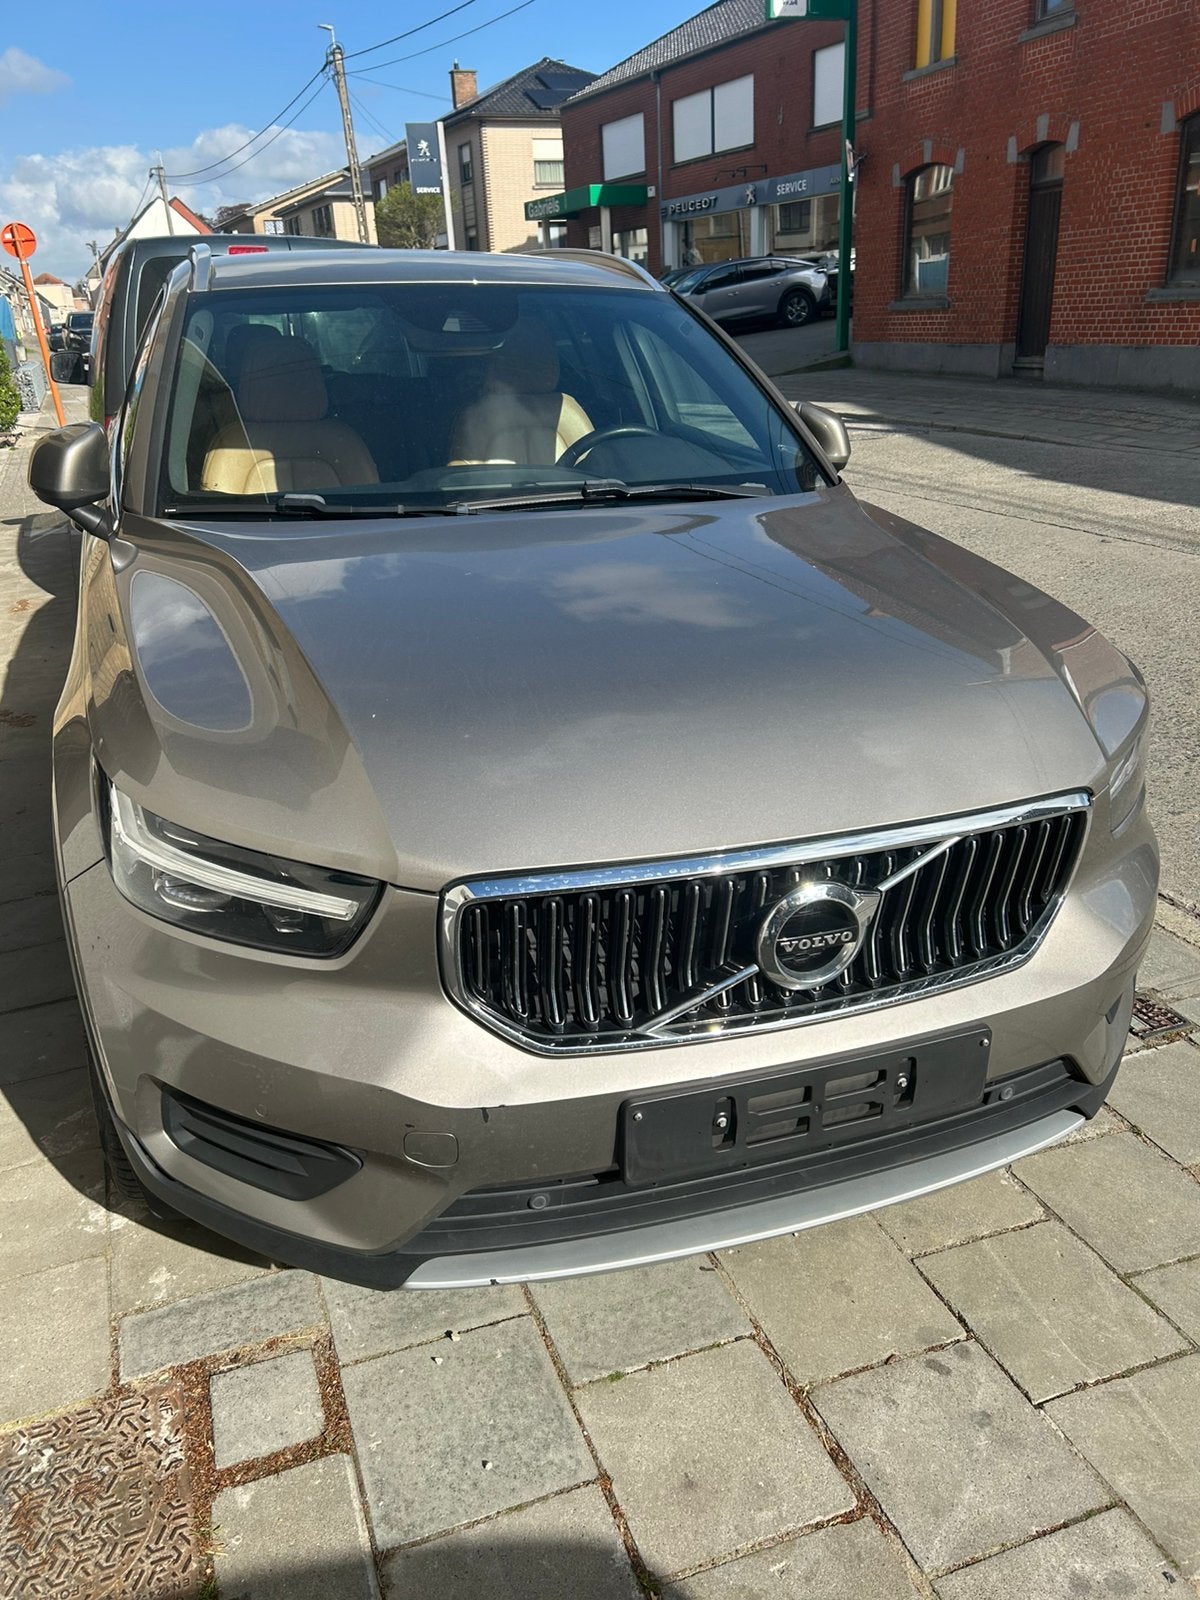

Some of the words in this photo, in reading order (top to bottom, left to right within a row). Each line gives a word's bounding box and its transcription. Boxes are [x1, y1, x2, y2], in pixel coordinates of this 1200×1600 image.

[776, 179, 807, 196] SERVICE
[669, 195, 717, 215] PEUGEOT
[780, 931, 853, 953] VOLVO
[129, 1479, 143, 1518] RWA
